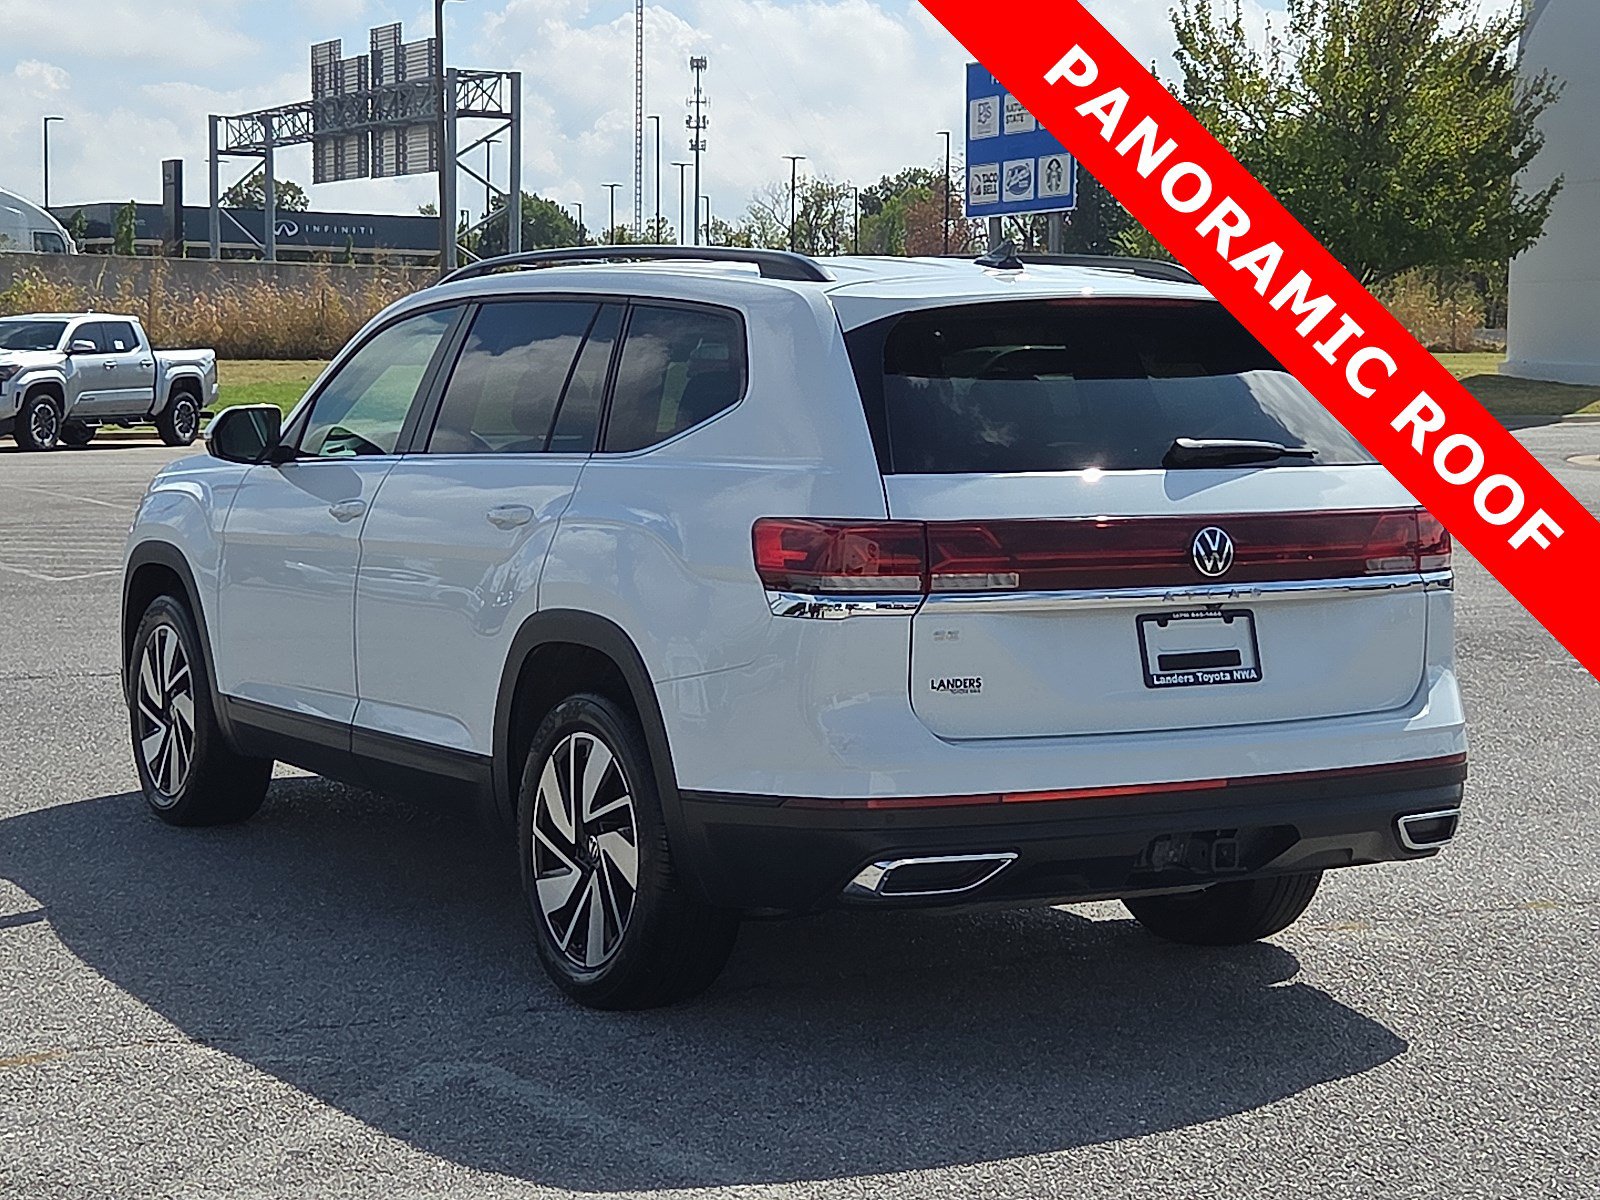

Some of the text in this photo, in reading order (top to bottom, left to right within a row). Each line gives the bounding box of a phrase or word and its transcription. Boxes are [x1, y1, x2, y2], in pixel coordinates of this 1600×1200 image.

[982, 173, 998, 183] TACO
[983, 184, 998, 195] BELL
[305, 224, 374, 235] INFINITI
[1153, 669, 1258, 685] Landers Toyota NWA
[930, 677, 982, 691] LANDERS
